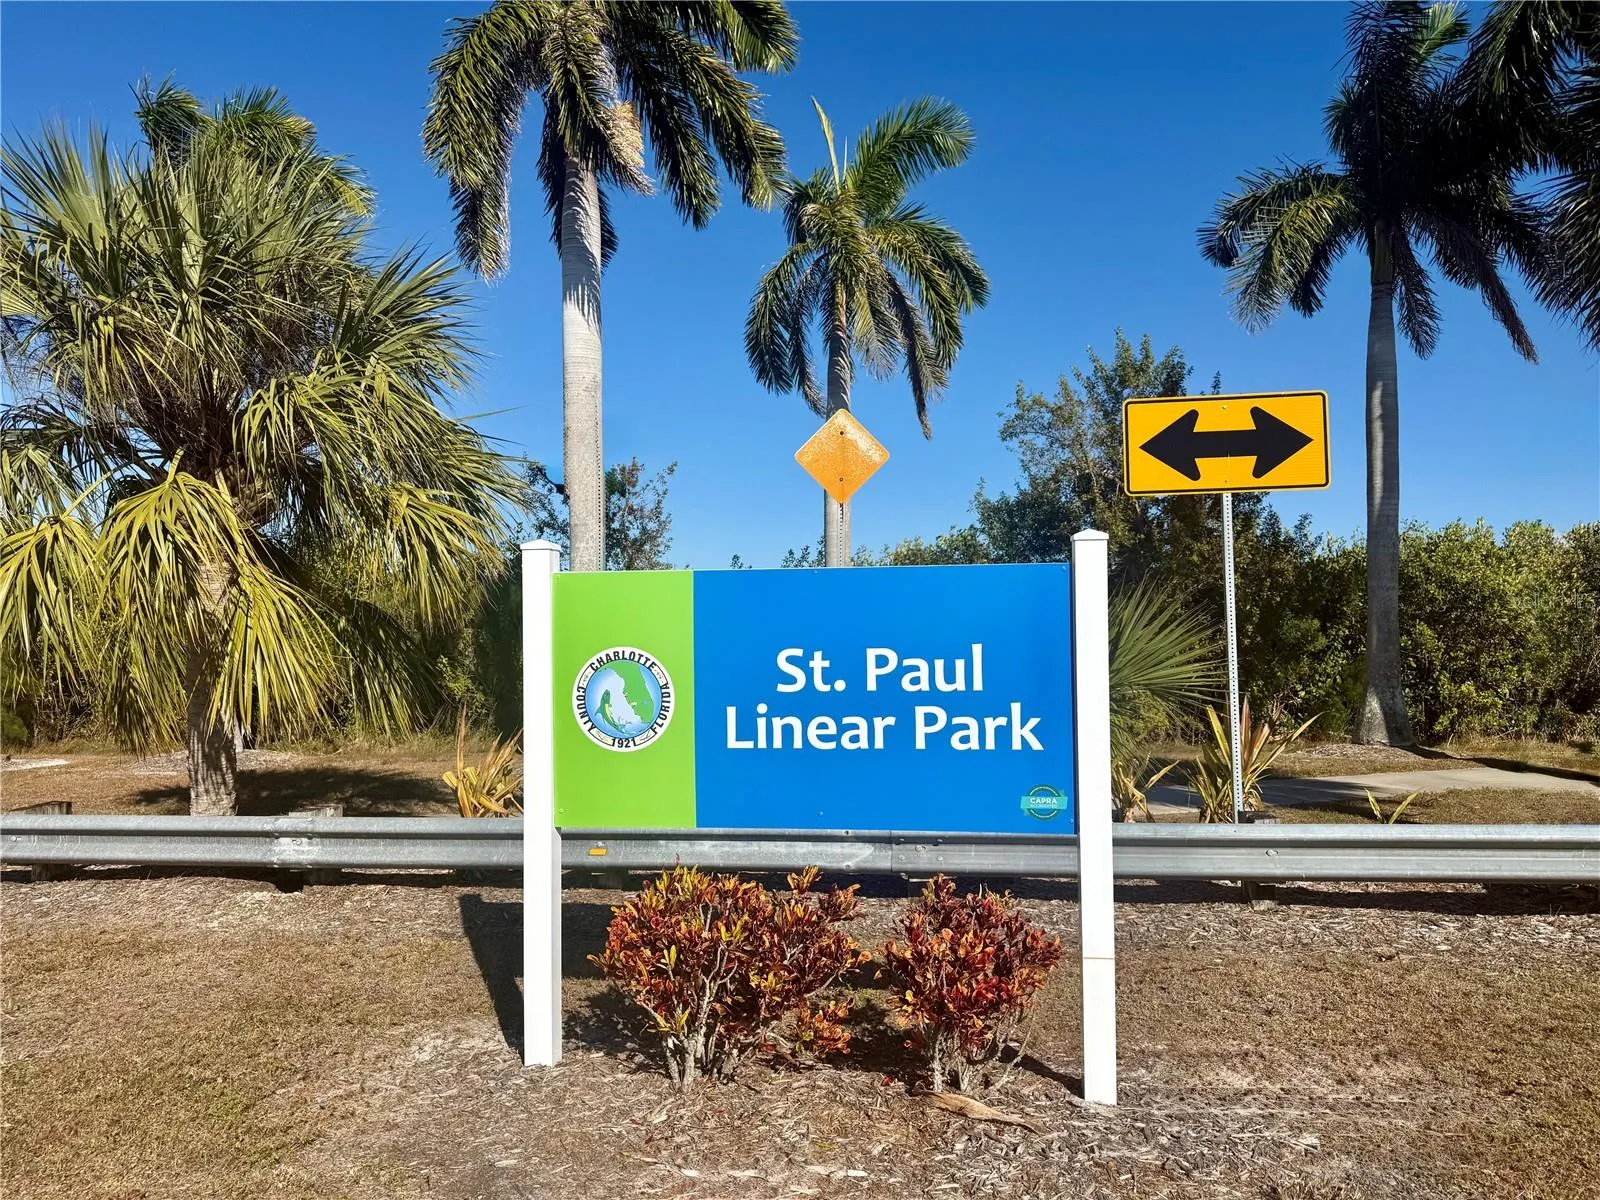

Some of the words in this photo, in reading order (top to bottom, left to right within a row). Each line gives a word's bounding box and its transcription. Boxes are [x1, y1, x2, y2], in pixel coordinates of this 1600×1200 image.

[589, 650, 657, 672] CHARLOTTE
[776, 648, 847, 693] St.
[866, 643, 983, 692] Paul
[576, 686, 597, 732] COUNTY
[650, 681, 671, 735] FLORIDA
[726, 703, 896, 750] Linear
[914, 702, 1044, 751] Park
[611, 738, 637, 748] 1921
[1030, 797, 1058, 805] CAPRA
